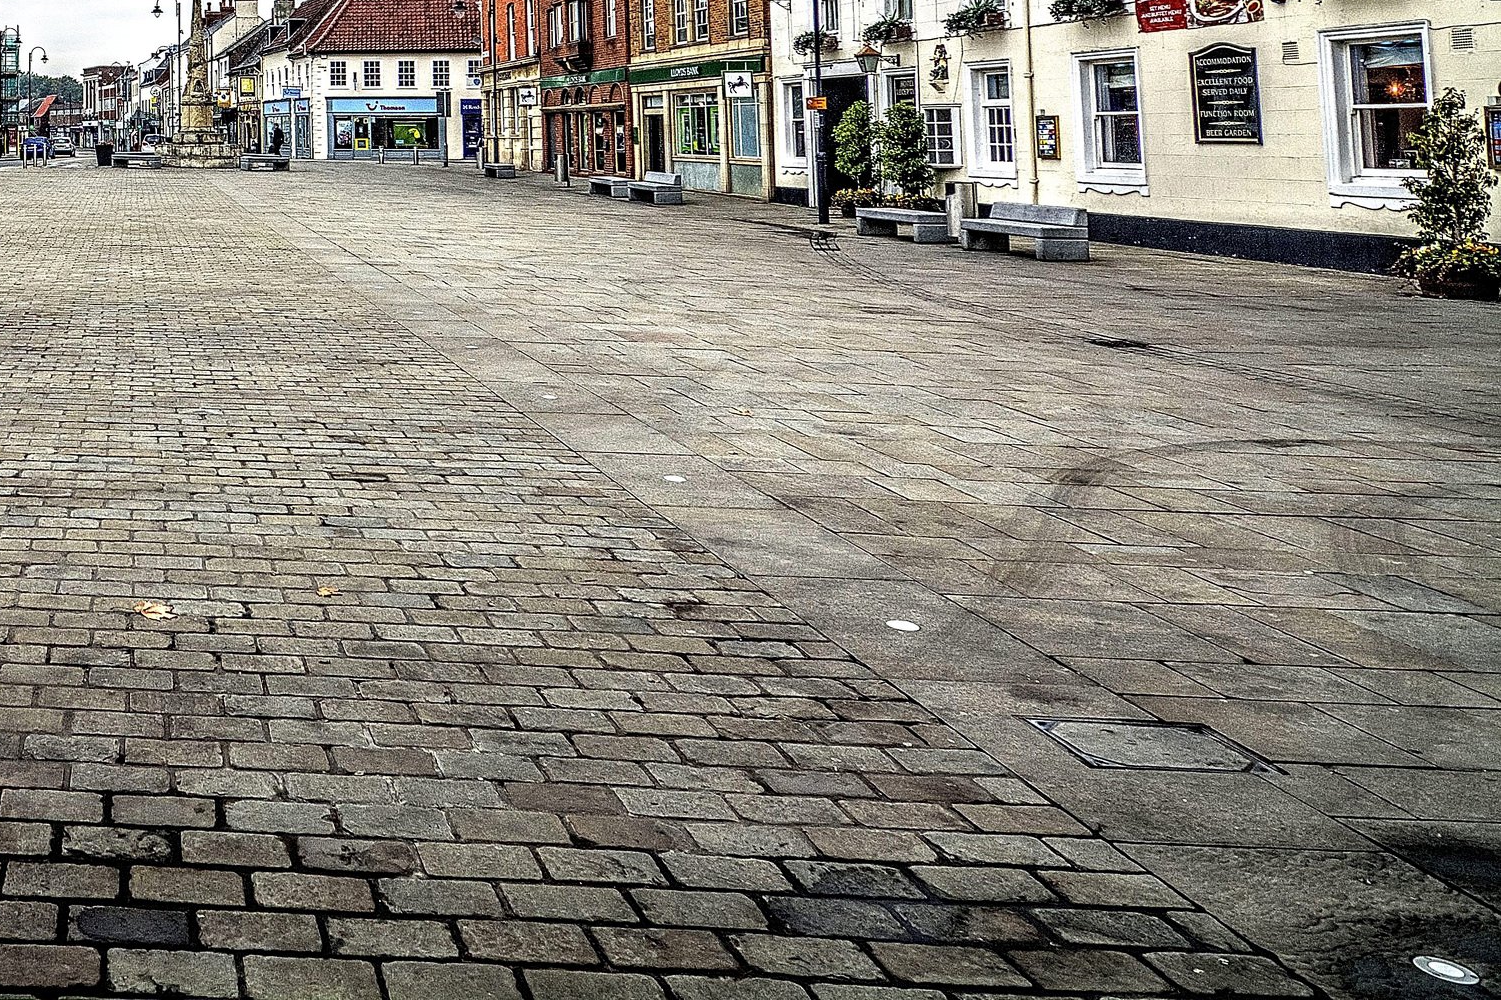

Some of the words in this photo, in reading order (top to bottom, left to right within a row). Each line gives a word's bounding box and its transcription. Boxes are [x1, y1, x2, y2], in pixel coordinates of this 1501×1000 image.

[1196, 56, 1252, 66] ACCOMMODATION
[1197, 77, 1232, 86] EXCELLENT
[1234, 76, 1253, 85] FOOD
[1202, 88, 1228, 96] SERVED
[1229, 87, 1248, 95] DAILY
[1200, 110, 1233, 118] FUNCTION
[1234, 109, 1255, 117] ROOM
[1206, 129, 1223, 137] BEER
[1224, 129, 1252, 137] GARDEN
